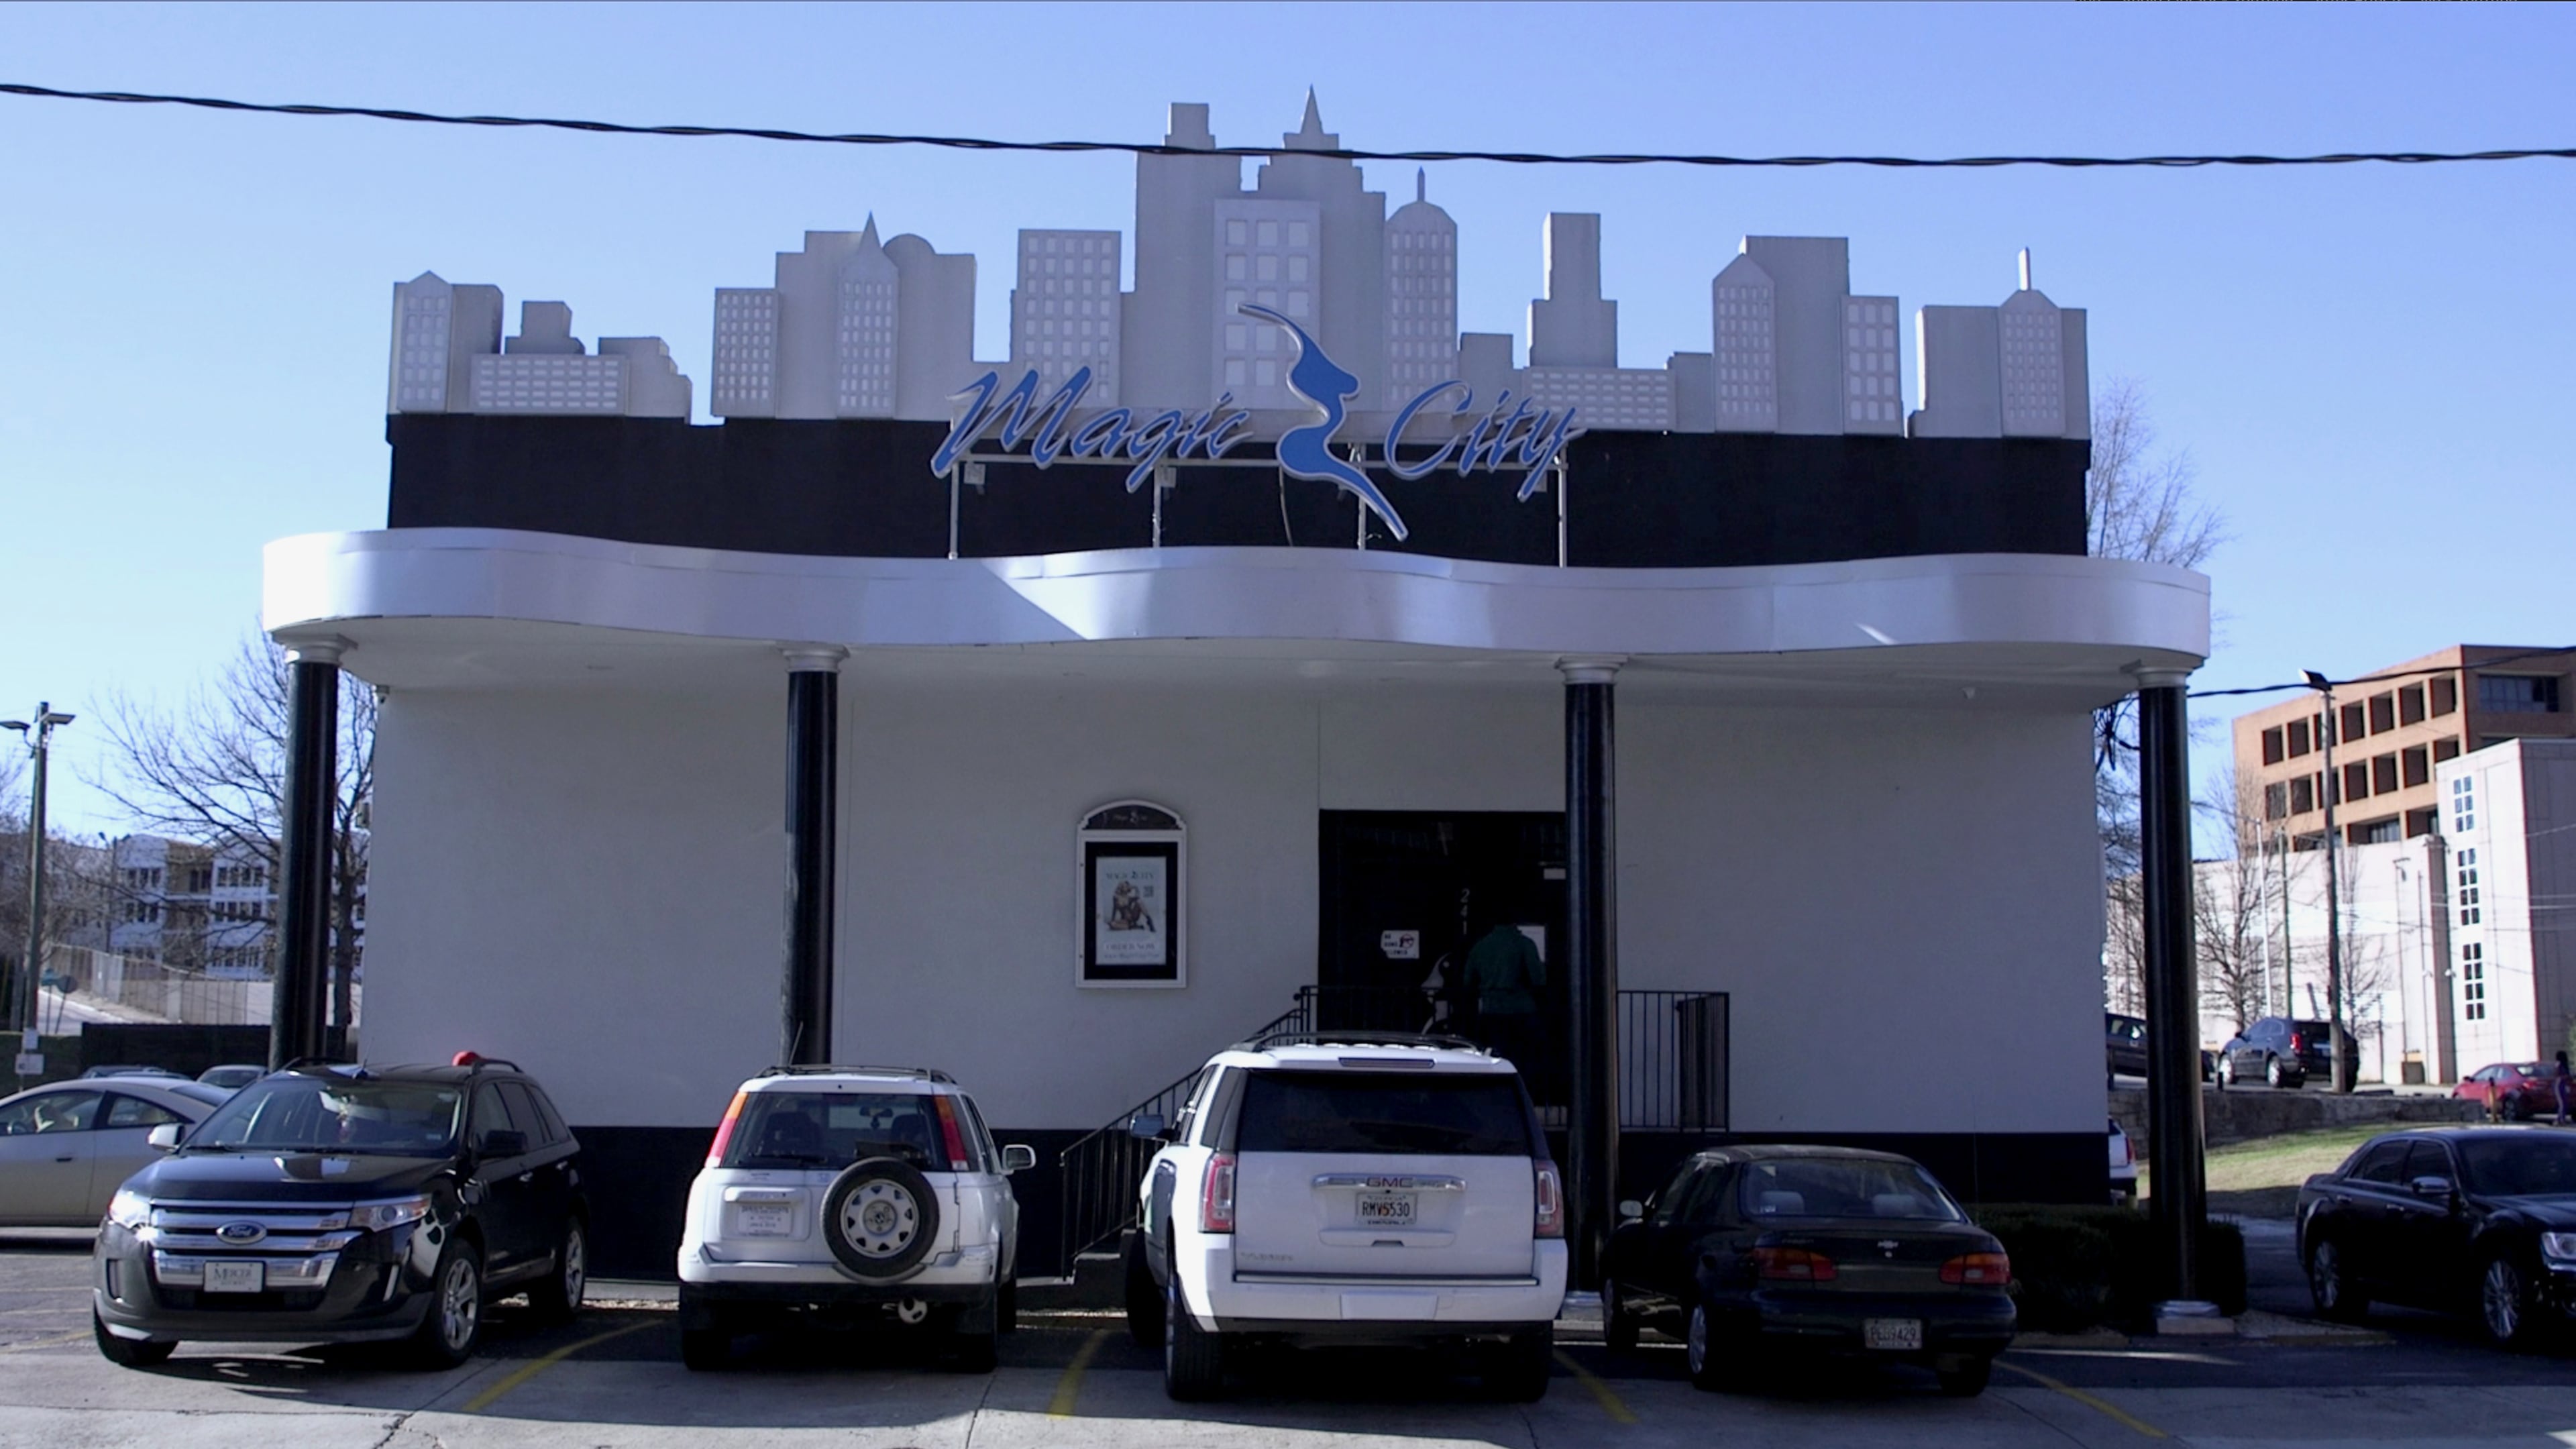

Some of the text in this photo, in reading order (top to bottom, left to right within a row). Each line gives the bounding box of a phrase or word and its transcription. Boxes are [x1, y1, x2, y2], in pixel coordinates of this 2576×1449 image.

[931, 366, 1588, 502] Magic City
[1366, 1177, 1413, 1187] GMC
[227, 1225, 252, 1237] Ford
